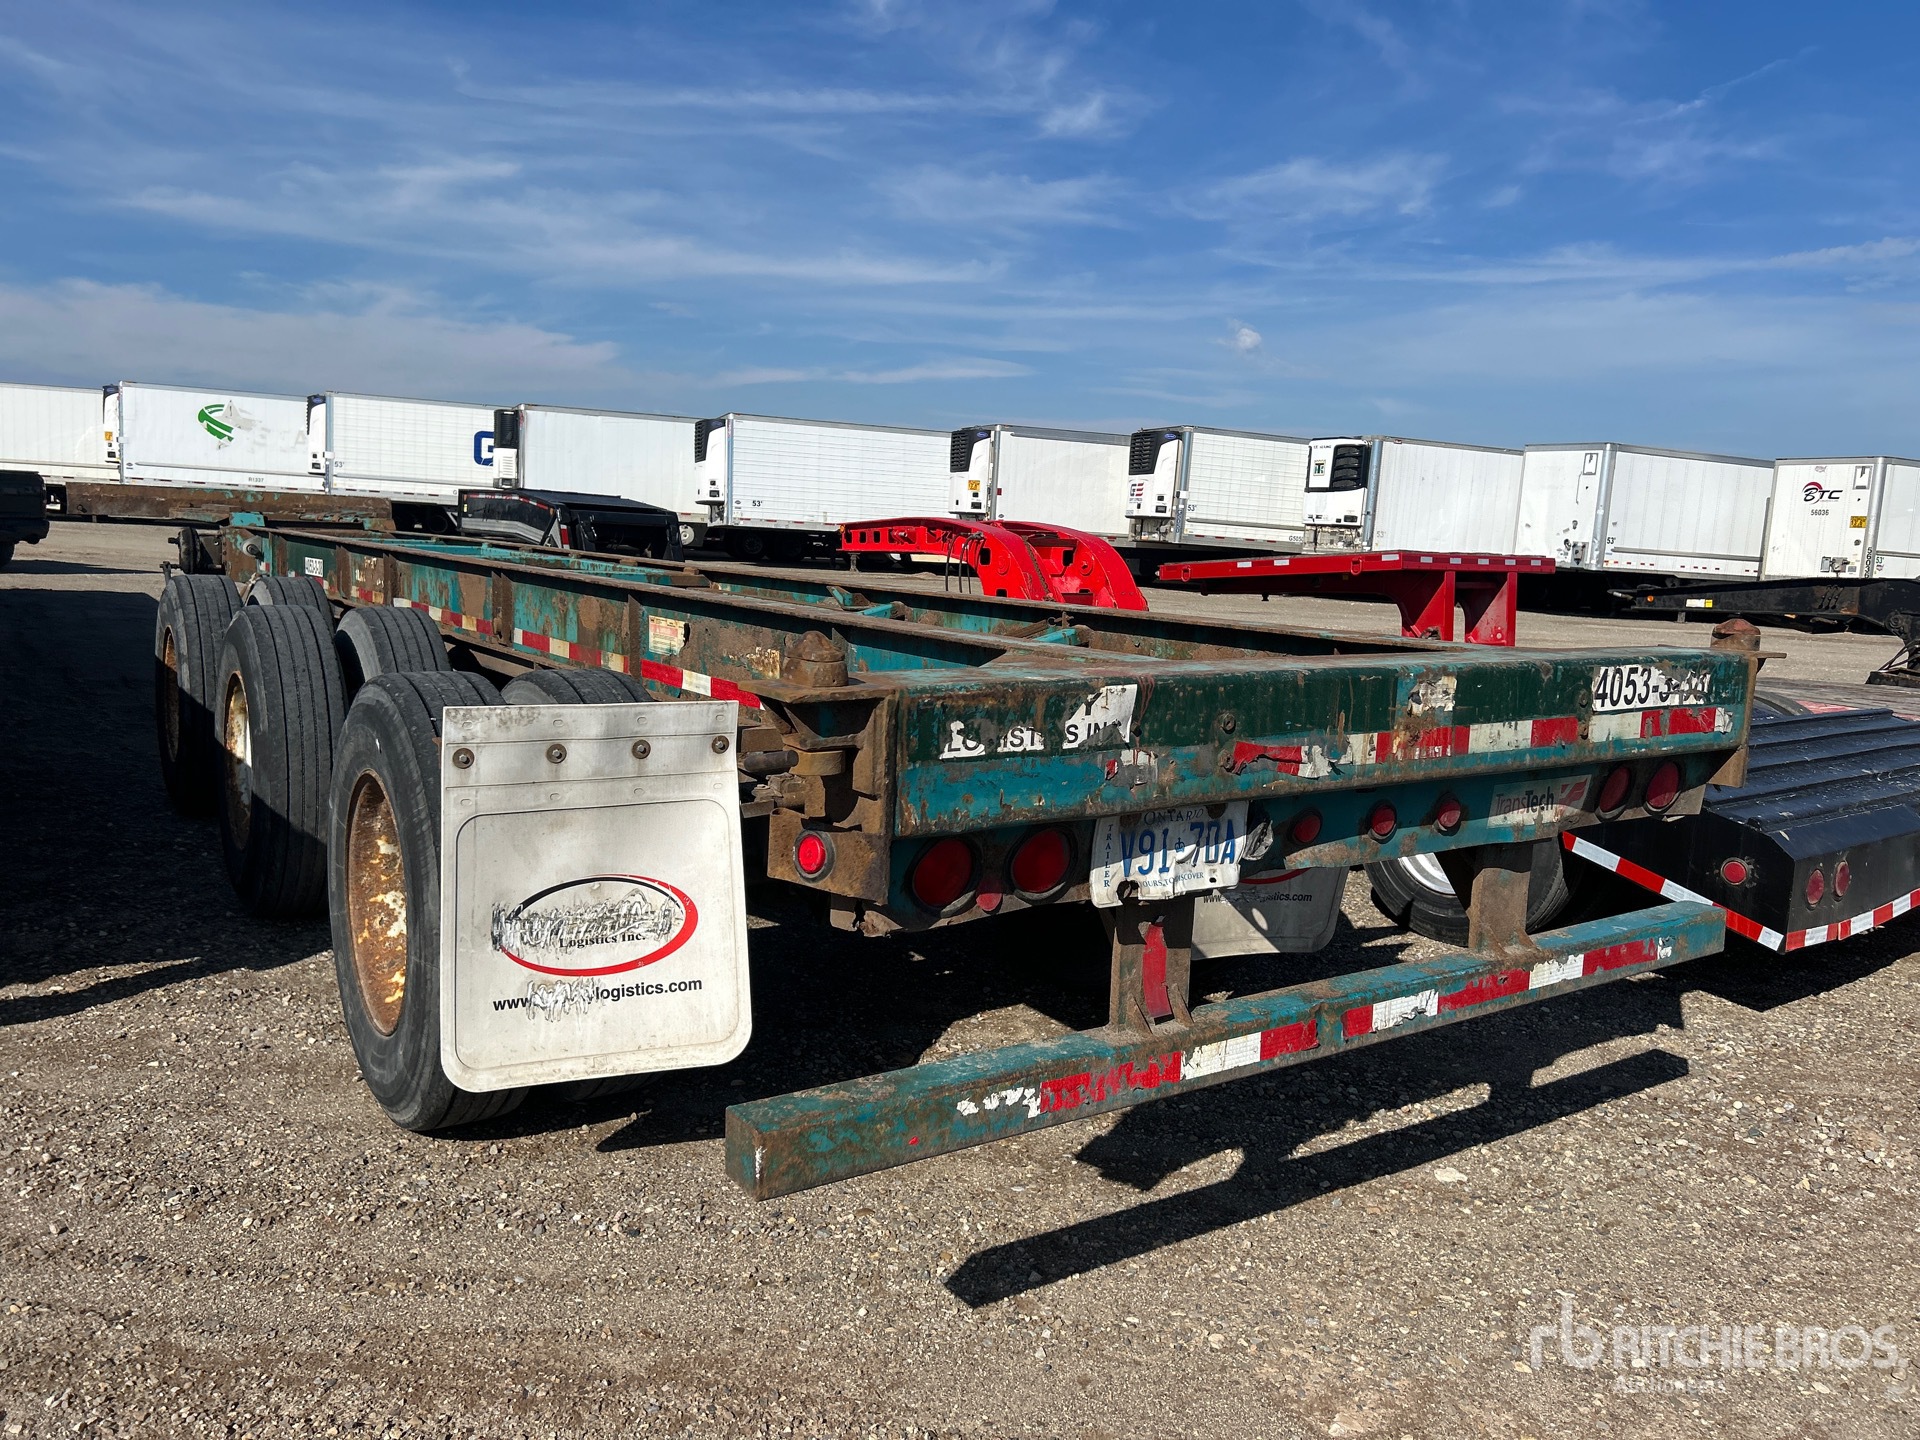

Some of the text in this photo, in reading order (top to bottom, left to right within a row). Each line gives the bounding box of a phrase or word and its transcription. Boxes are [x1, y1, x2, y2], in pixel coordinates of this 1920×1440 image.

[1803, 486, 1843, 503] BTC
[1496, 786, 1555, 816] TransTech
[1143, 808, 1204, 825] ONTARIO
[1103, 823, 1113, 888] TRAILER
[1120, 828, 1170, 878] V91
[559, 932, 646, 949] Logistics Inc.
